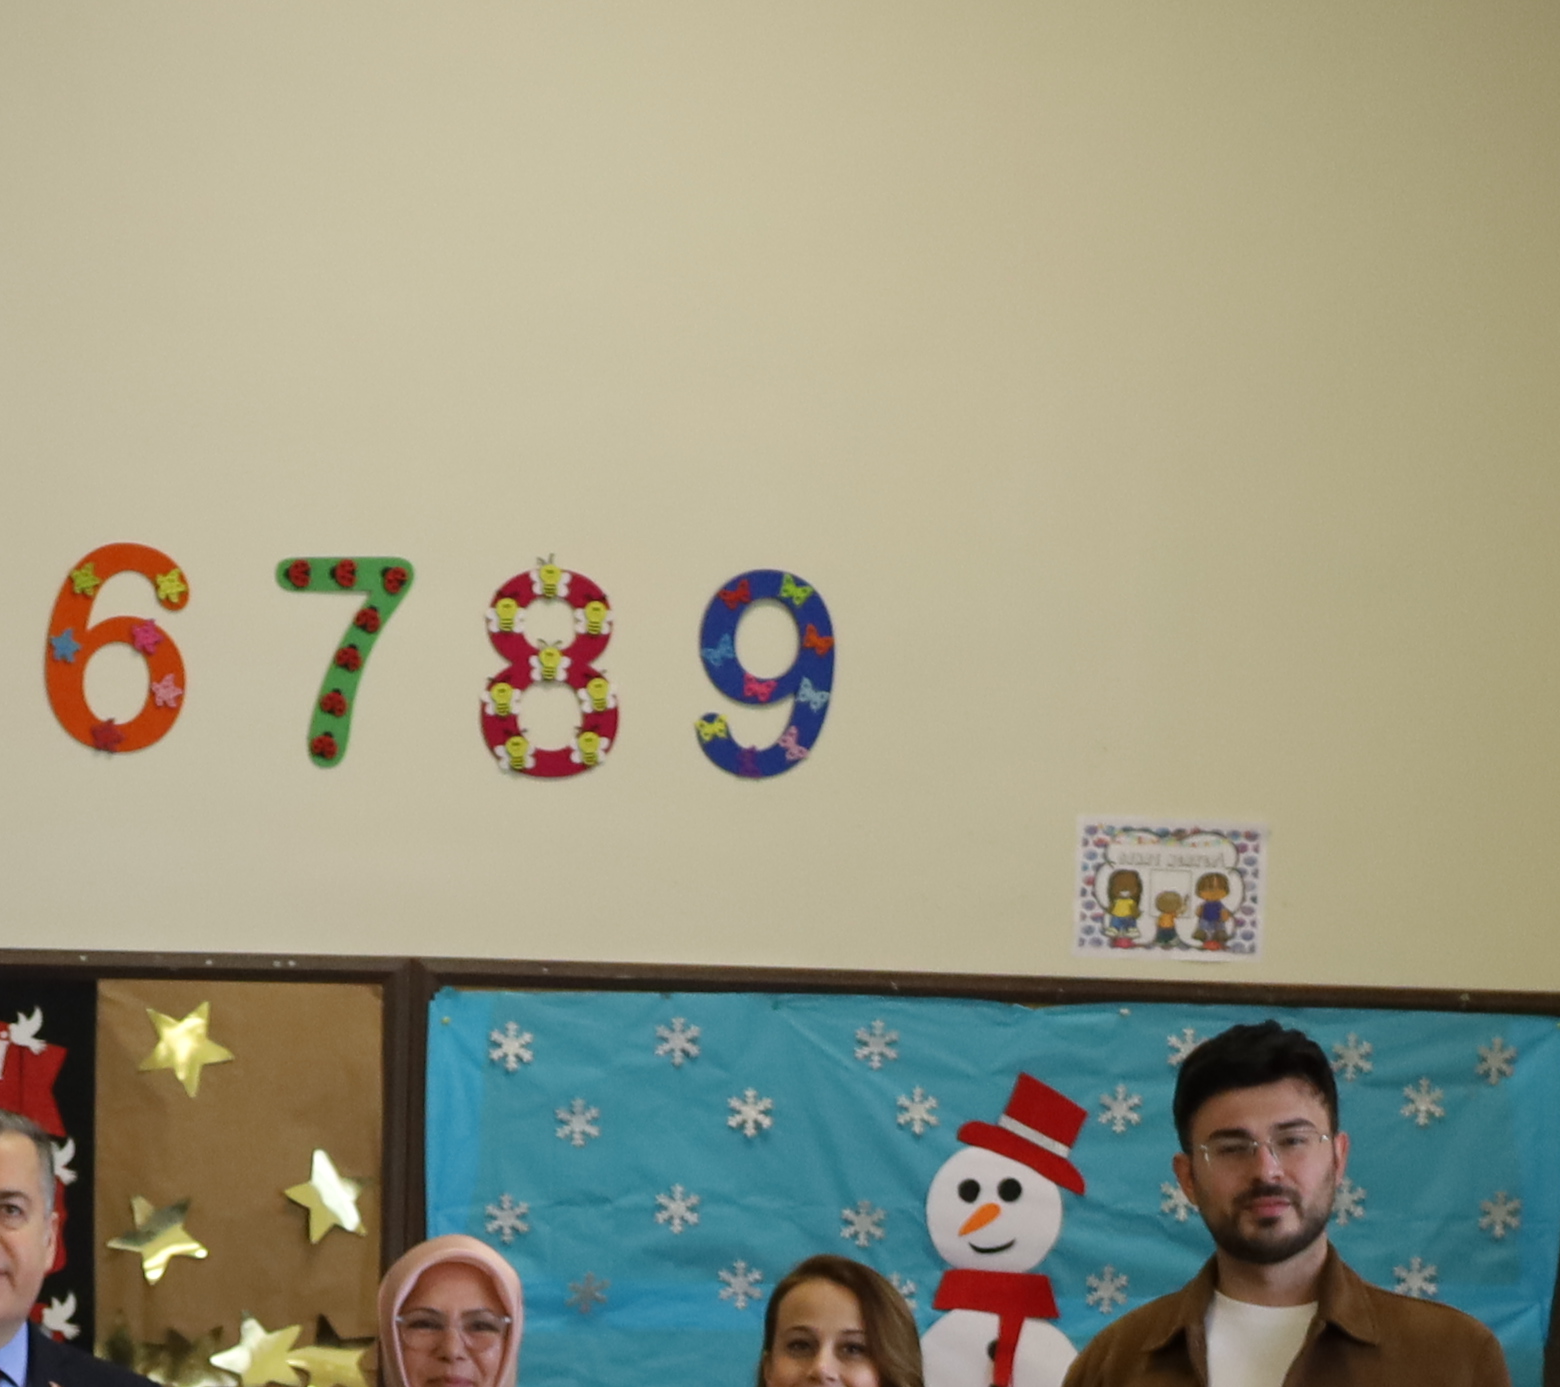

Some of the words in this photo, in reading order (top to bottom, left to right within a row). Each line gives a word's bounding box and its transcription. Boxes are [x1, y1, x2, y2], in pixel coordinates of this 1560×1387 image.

[45, 542, 188, 753] 6
[276, 556, 414, 768] 7
[479, 558, 619, 779] 8
[695, 568, 836, 780] 9
